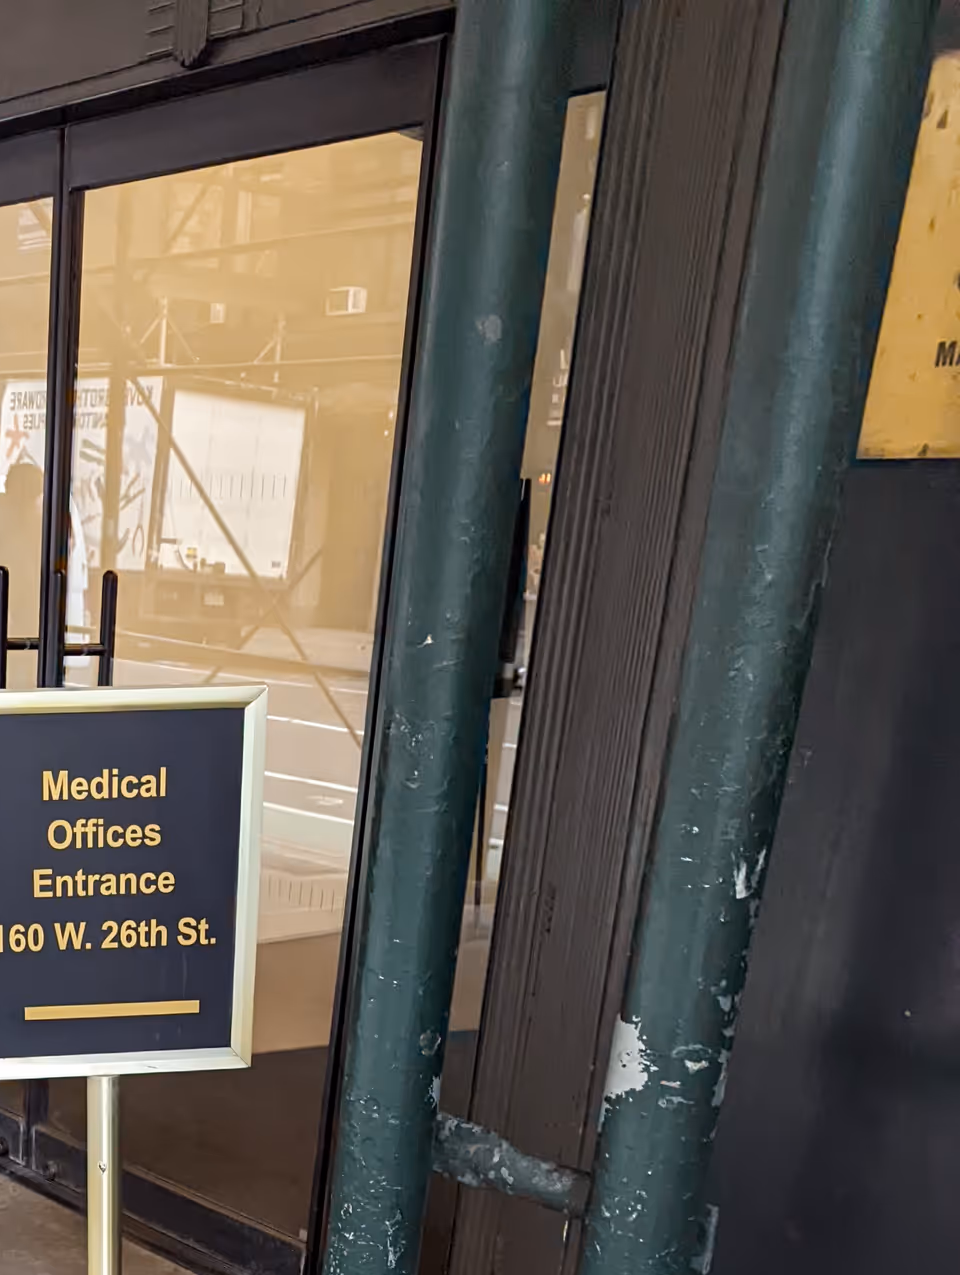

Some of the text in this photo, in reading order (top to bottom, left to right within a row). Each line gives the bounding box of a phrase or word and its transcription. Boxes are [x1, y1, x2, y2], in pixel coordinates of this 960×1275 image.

[42, 766, 167, 801] Medical
[47, 818, 161, 850] Offices
[33, 868, 176, 898] Entrance
[53, 921, 92, 951] W.
[100, 919, 168, 949] 26th
[176, 917, 217, 946] St.
